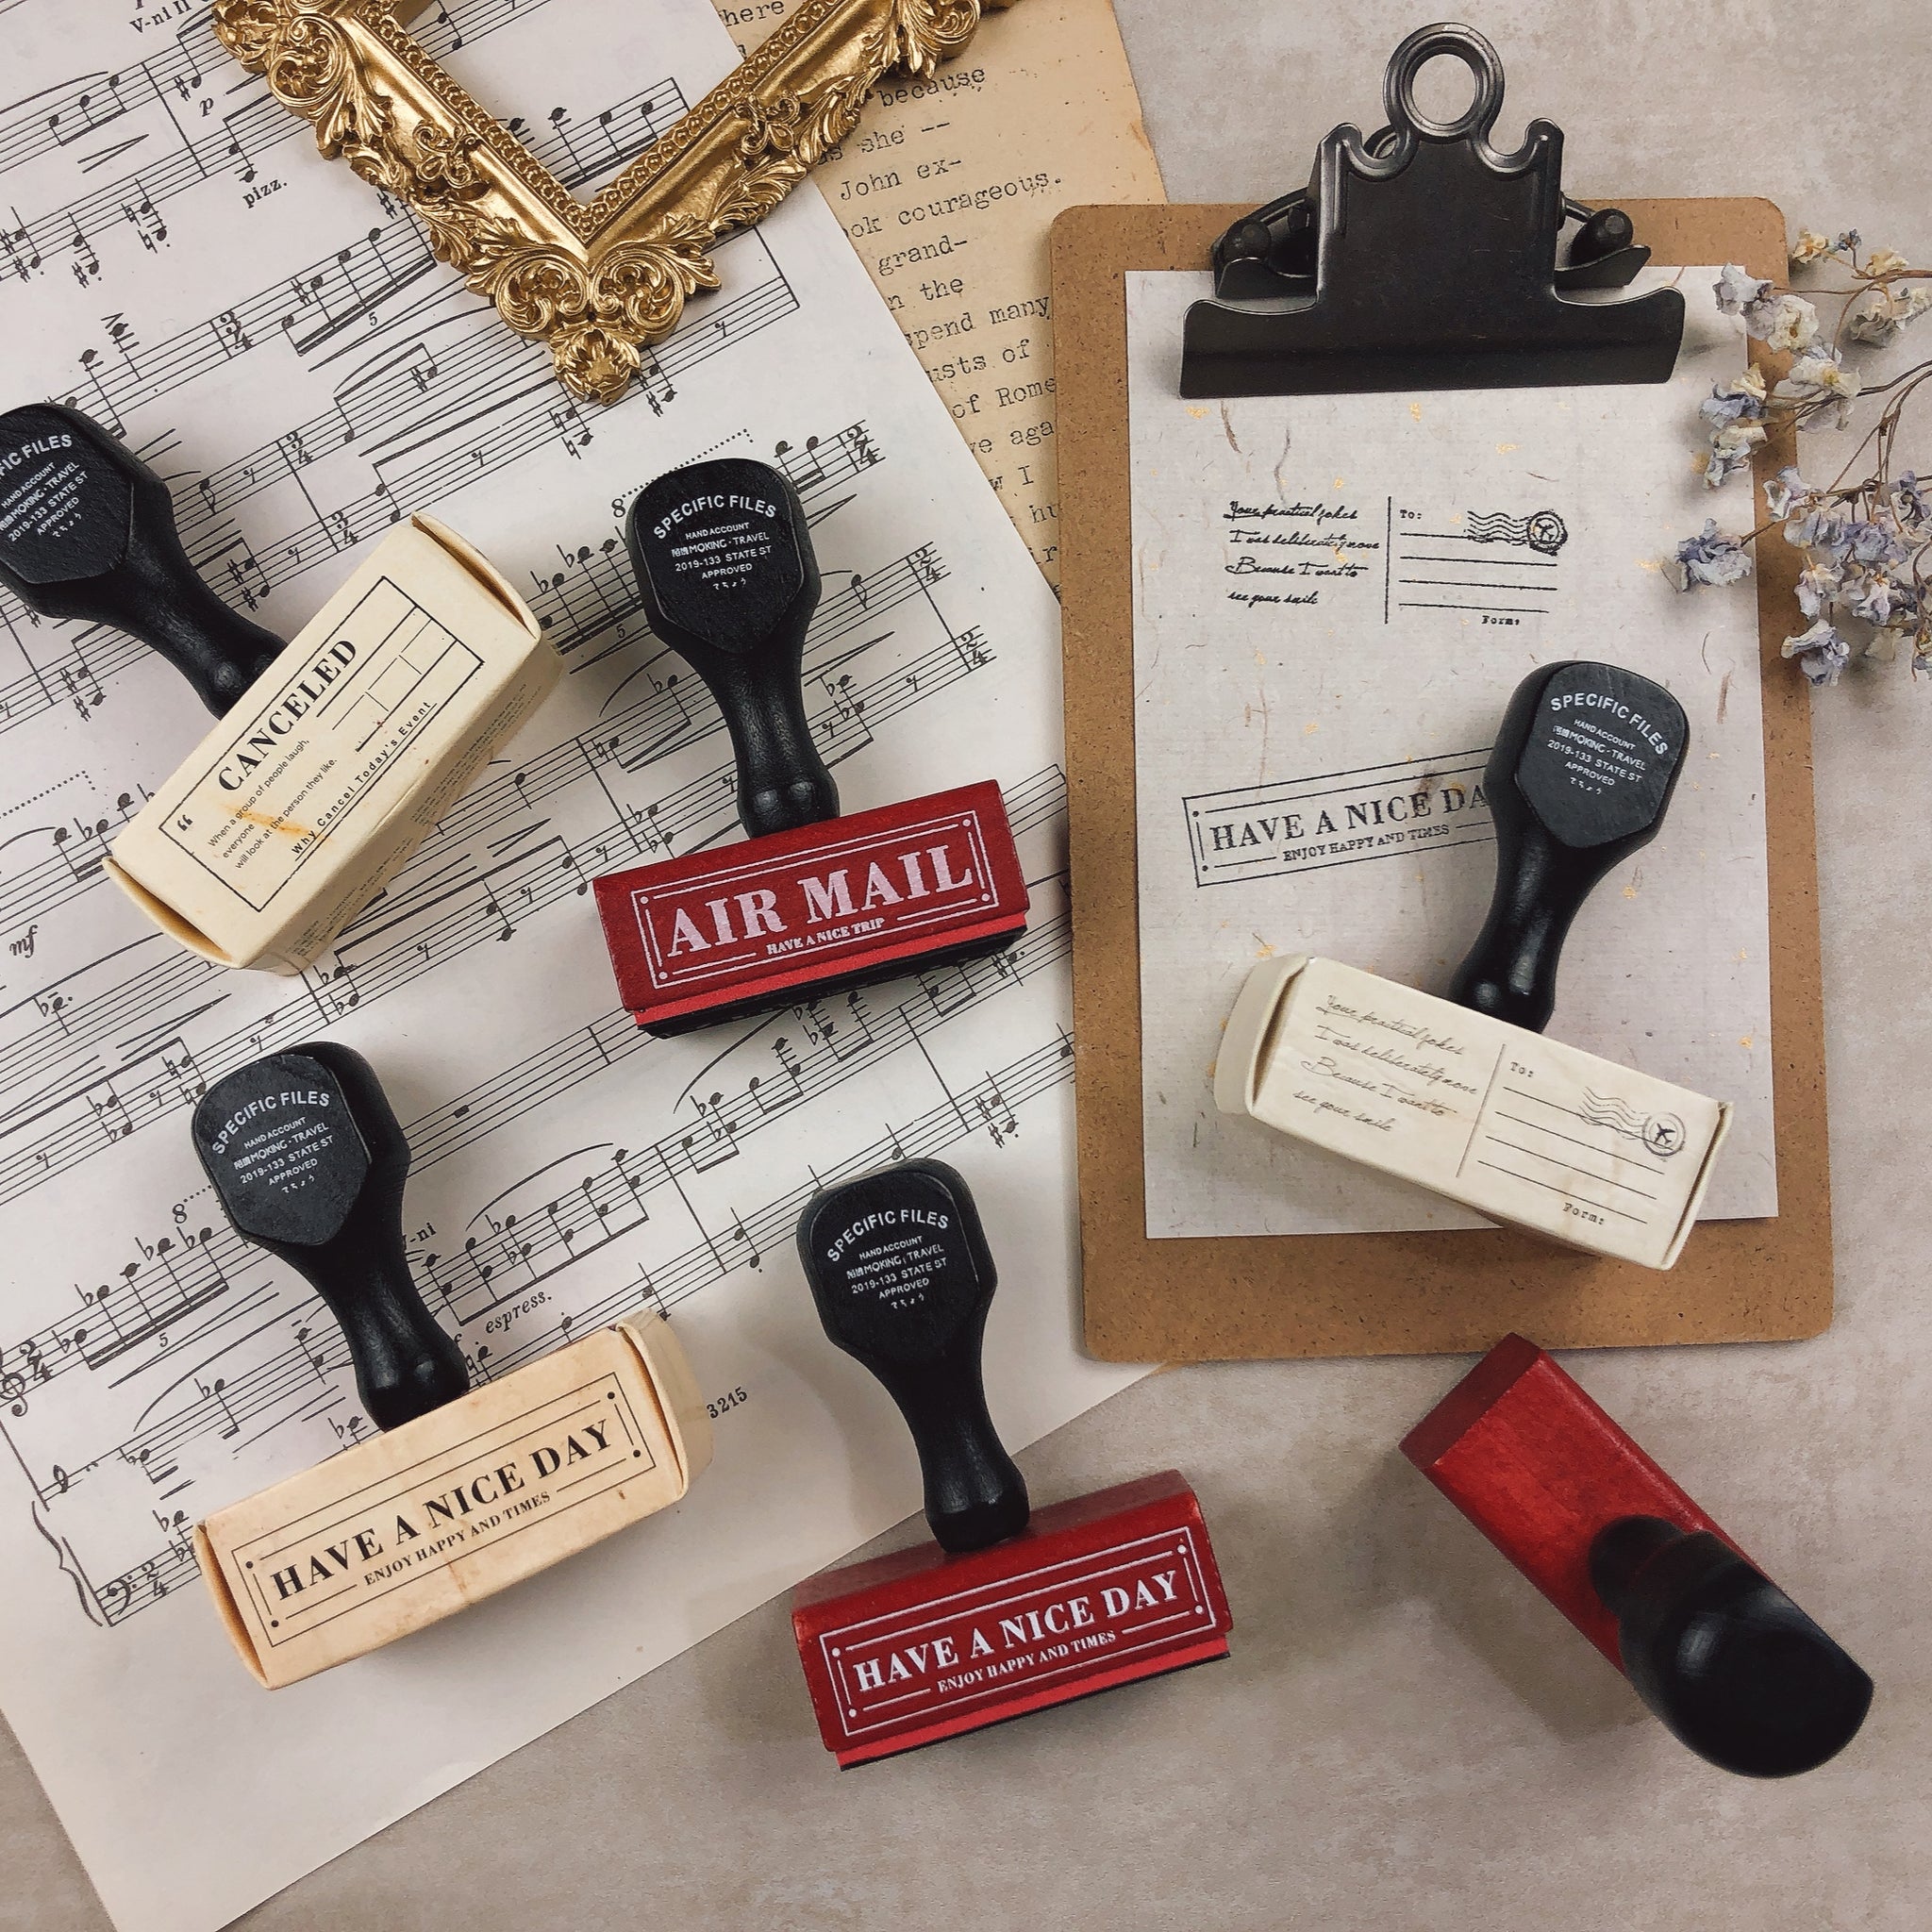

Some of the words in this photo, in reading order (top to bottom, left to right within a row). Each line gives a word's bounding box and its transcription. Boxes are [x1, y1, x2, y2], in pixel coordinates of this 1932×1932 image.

[129, 7, 173, 33] V-ni
[718, 1, 784, 26] here
[878, 68, 987, 108] because
[860, 130, 905, 153] she
[242, 178, 287, 208] pizz.
[841, 171, 903, 201] John
[917, 158, 961, 179] ex-
[898, 171, 1062, 225] courageous.
[878, 237, 969, 275] grand-
[920, 278, 963, 301] the
[1002, 339, 1030, 363] of
[952, 393, 980, 418] of
[995, 378, 1056, 408] Rome
[22, 435, 72, 458] FILES
[1018, 465, 1034, 485] I
[8, 506, 48, 542] 2019-133
[47, 481, 77, 508] STATE
[75, 471, 89, 485] ST
[37, 496, 79, 536] APPROVED
[654, 495, 724, 540] SPECIFIC
[729, 495, 776, 518] FILES
[675, 556, 721, 572] 2019-133
[725, 549, 758, 562] STATE
[759, 545, 773, 555] ST
[702, 563, 753, 579] APPROVED
[218, 640, 357, 791] CANCELED
[1550, 692, 1630, 719] SPECIFIC
[1628, 713, 1669, 756] FILES
[291, 830, 317, 855] Why
[317, 786, 356, 826] Cancel
[355, 739, 398, 784] Today's
[397, 701, 431, 736] Event
[1547, 740, 1592, 763] 2019-133
[1594, 758, 1627, 778] STATE
[1626, 772, 1643, 783] ST
[1564, 761, 1615, 786] APPROVED
[208, 824, 231, 847] When
[235, 796, 257, 819] group
[256, 784, 265, 796] of
[264, 762, 289, 788] people
[288, 739, 310, 763] laugh,
[235, 854, 249, 870] will
[248, 838, 265, 856] look
[264, 829, 273, 840] at
[271, 817, 283, 830] the
[283, 791, 308, 818] person
[306, 771, 324, 790] they
[322, 759, 338, 773] like.
[1209, 814, 1305, 851] HAVE
[1315, 809, 1338, 835] A
[1344, 791, 1431, 830] NICE
[1441, 784, 1488, 813] DA
[223, 824, 256, 858] everyone
[1283, 845, 1326, 862] ENJOY
[1329, 838, 1374, 854] HAPPY
[1377, 832, 1406, 846] AND
[1407, 824, 1450, 841] TIMES
[667, 887, 789, 958] AIR
[797, 844, 974, 924] MAIL
[766, 936, 805, 955] HAVE
[805, 932, 817, 946] A
[817, 924, 851, 943] NICE
[851, 917, 886, 936] TRIP
[1509, 1061, 1534, 1078] To:
[212, 1095, 277, 1155] SPECIFIC
[279, 1091, 330, 1108] FILES
[240, 1158, 286, 1184] 2019-133
[287, 1144, 321, 1162] STATE
[320, 1135, 334, 1148] ST
[268, 1158, 318, 1186] APPROVED
[1563, 1202, 1606, 1226] Form:
[826, 1210, 896, 1262] SPECIFIC
[900, 1208, 949, 1229] FILES
[851, 1273, 897, 1294] 2019-133
[900, 1262, 933, 1278] STATE
[934, 1257, 947, 1269] ST
[878, 1277, 930, 1299] APPROVED
[486, 1291, 552, 1334] espress.
[707, 1386, 747, 1419] 3215
[269, 1528, 384, 1602] HAVE
[393, 1514, 421, 1545] A
[422, 1460, 525, 1530] NICE
[529, 1418, 614, 1479] DAY
[363, 1554, 414, 1587] ENJOY
[415, 1529, 466, 1568] HAPPY
[470, 1516, 502, 1538] AND
[502, 1491, 550, 1522] TIMES
[853, 1636, 960, 1692] HAVE
[970, 1627, 994, 1659] A
[1000, 1595, 1096, 1650] NICE
[1102, 1570, 1177, 1618] DAY
[937, 1671, 984, 1694] ENJOY
[987, 1653, 1035, 1679] HAPPY
[1039, 1642, 1072, 1663] AND
[1071, 1629, 1116, 1655] TIMES
